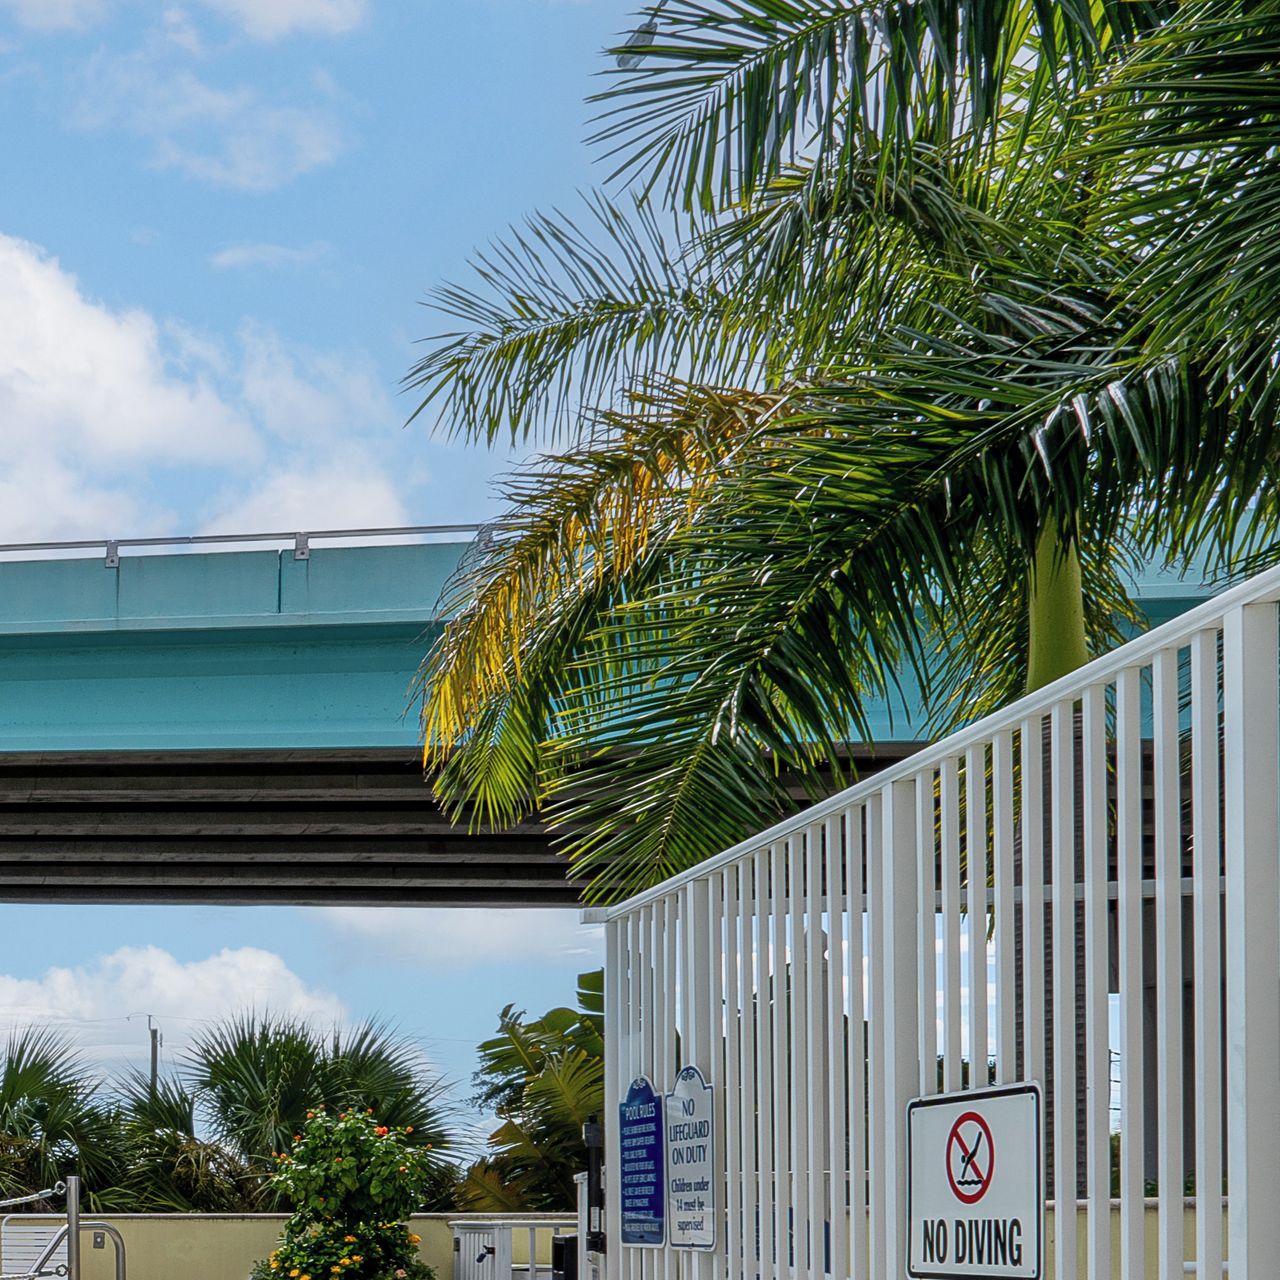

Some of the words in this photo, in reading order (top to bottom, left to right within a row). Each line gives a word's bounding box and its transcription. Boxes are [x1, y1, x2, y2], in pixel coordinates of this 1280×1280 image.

[625, 1106, 639, 1121] POOL
[640, 1103, 656, 1118] RULES
[682, 1098, 695, 1117] NO
[669, 1120, 710, 1142] LIFEGUARD
[672, 1147, 684, 1165] ON
[686, 1144, 708, 1163] DUTY
[671, 1177, 692, 1194] Children
[693, 1176, 710, 1191] under
[676, 1198, 683, 1211] 14
[684, 1198, 696, 1211] must
[697, 1196, 705, 1211] be
[677, 1217, 704, 1235] supervised
[922, 1218, 948, 1264] NO
[954, 1218, 1023, 1267] DIVING
